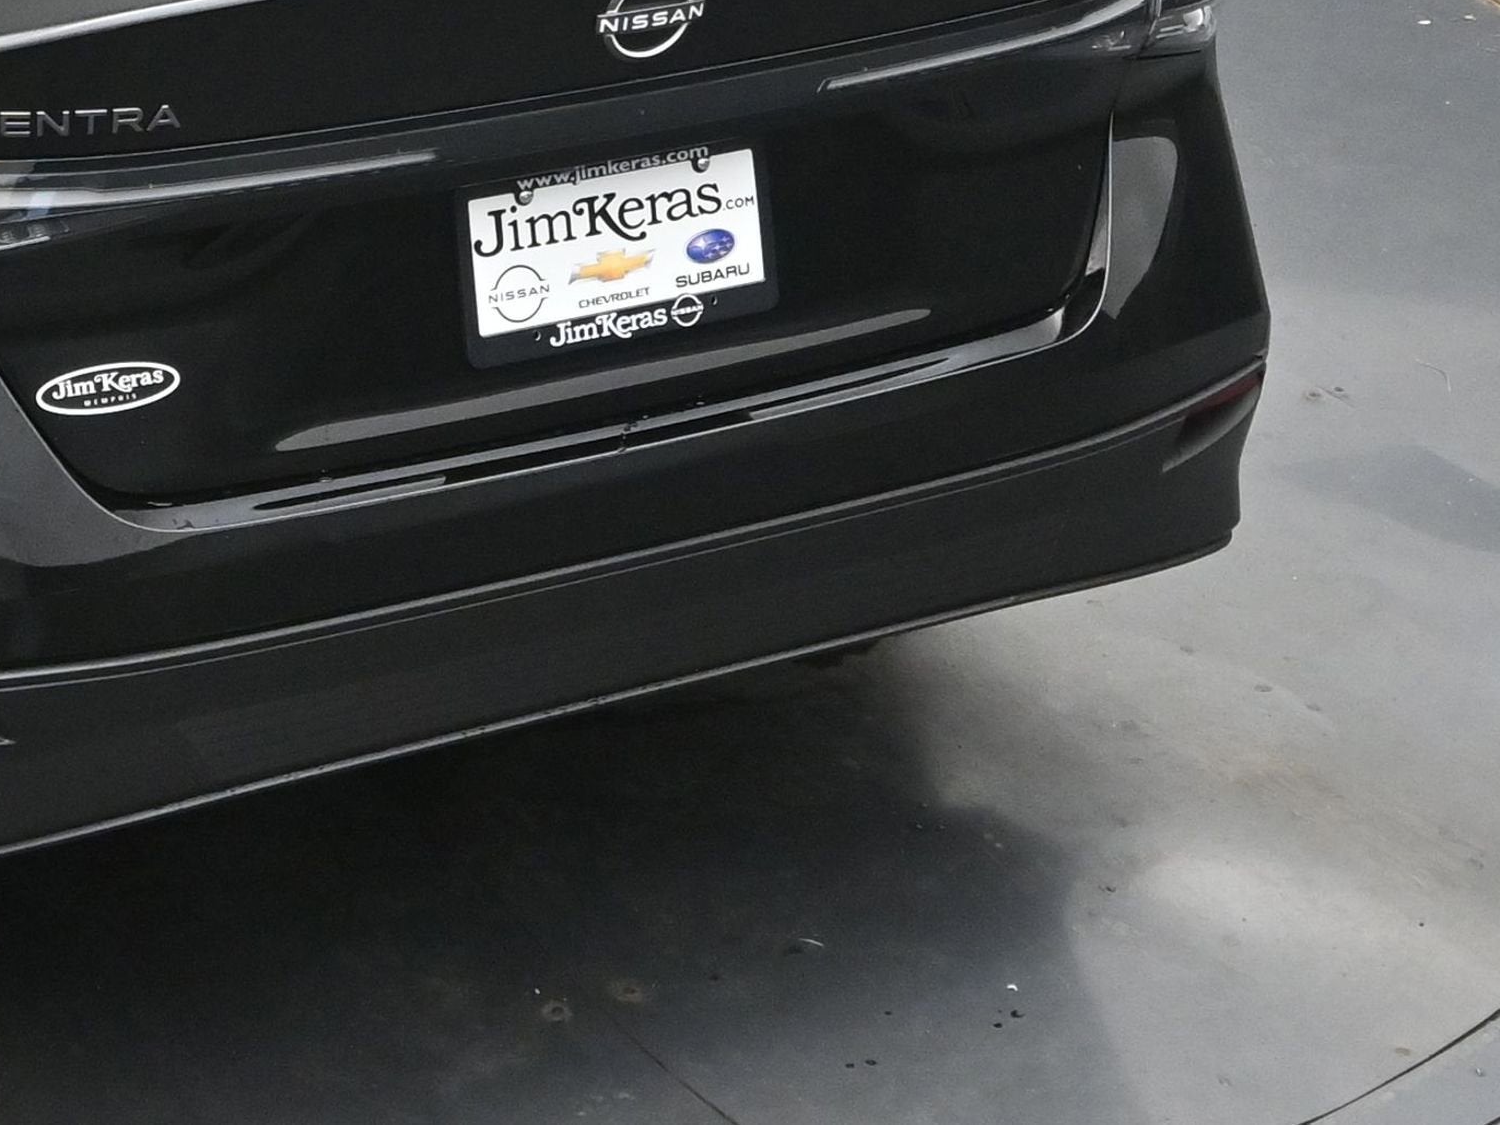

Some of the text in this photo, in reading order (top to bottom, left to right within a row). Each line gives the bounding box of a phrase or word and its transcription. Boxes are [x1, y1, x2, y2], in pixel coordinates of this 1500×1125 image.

[599, 2, 704, 33] NISSAN
[516, 145, 709, 191] www.jimkeras.com
[675, 262, 751, 289] SUBARU
[488, 284, 550, 304] NISSAN
[578, 286, 651, 309] CHEVROLET
